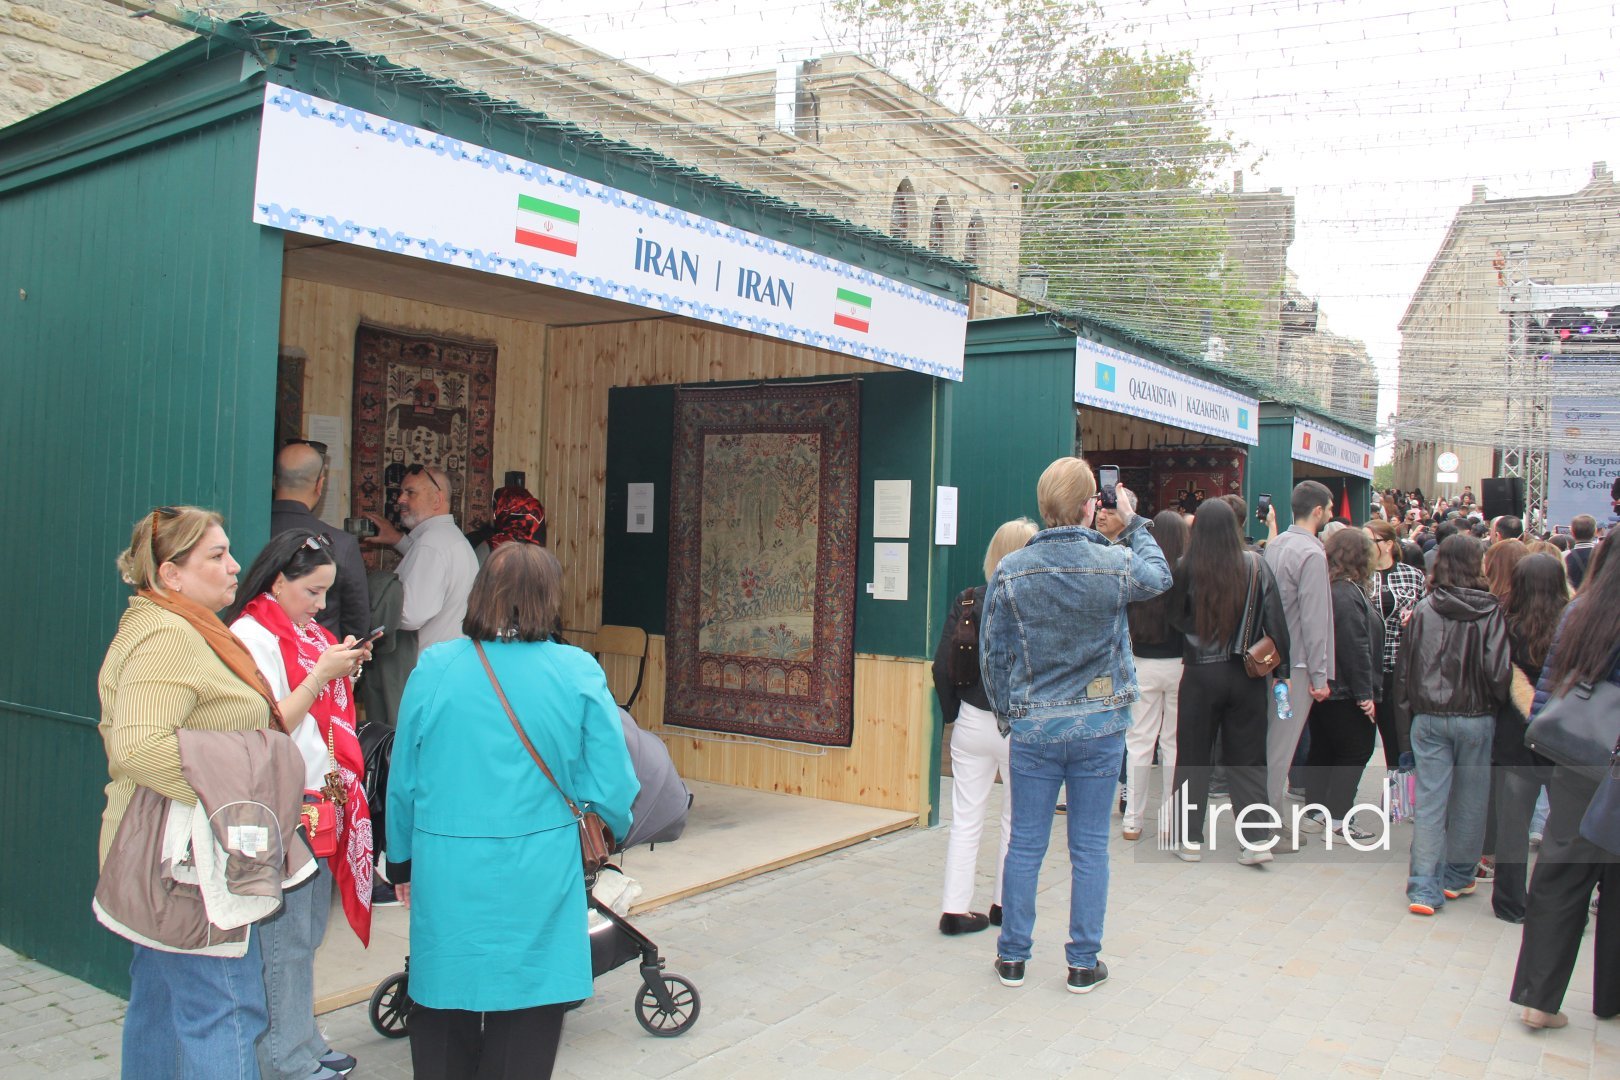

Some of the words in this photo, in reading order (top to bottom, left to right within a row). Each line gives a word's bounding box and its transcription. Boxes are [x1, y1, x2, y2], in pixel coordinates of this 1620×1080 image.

[634, 227, 699, 286] İRAN
[737, 267, 794, 311] IRAN
[1129, 378, 1177, 408] QAZAXISTAN
[1186, 395, 1230, 422] KAZAKHSTAN
[1563, 467, 1596, 479] Xalça
[1563, 479, 1584, 491] Xoş
